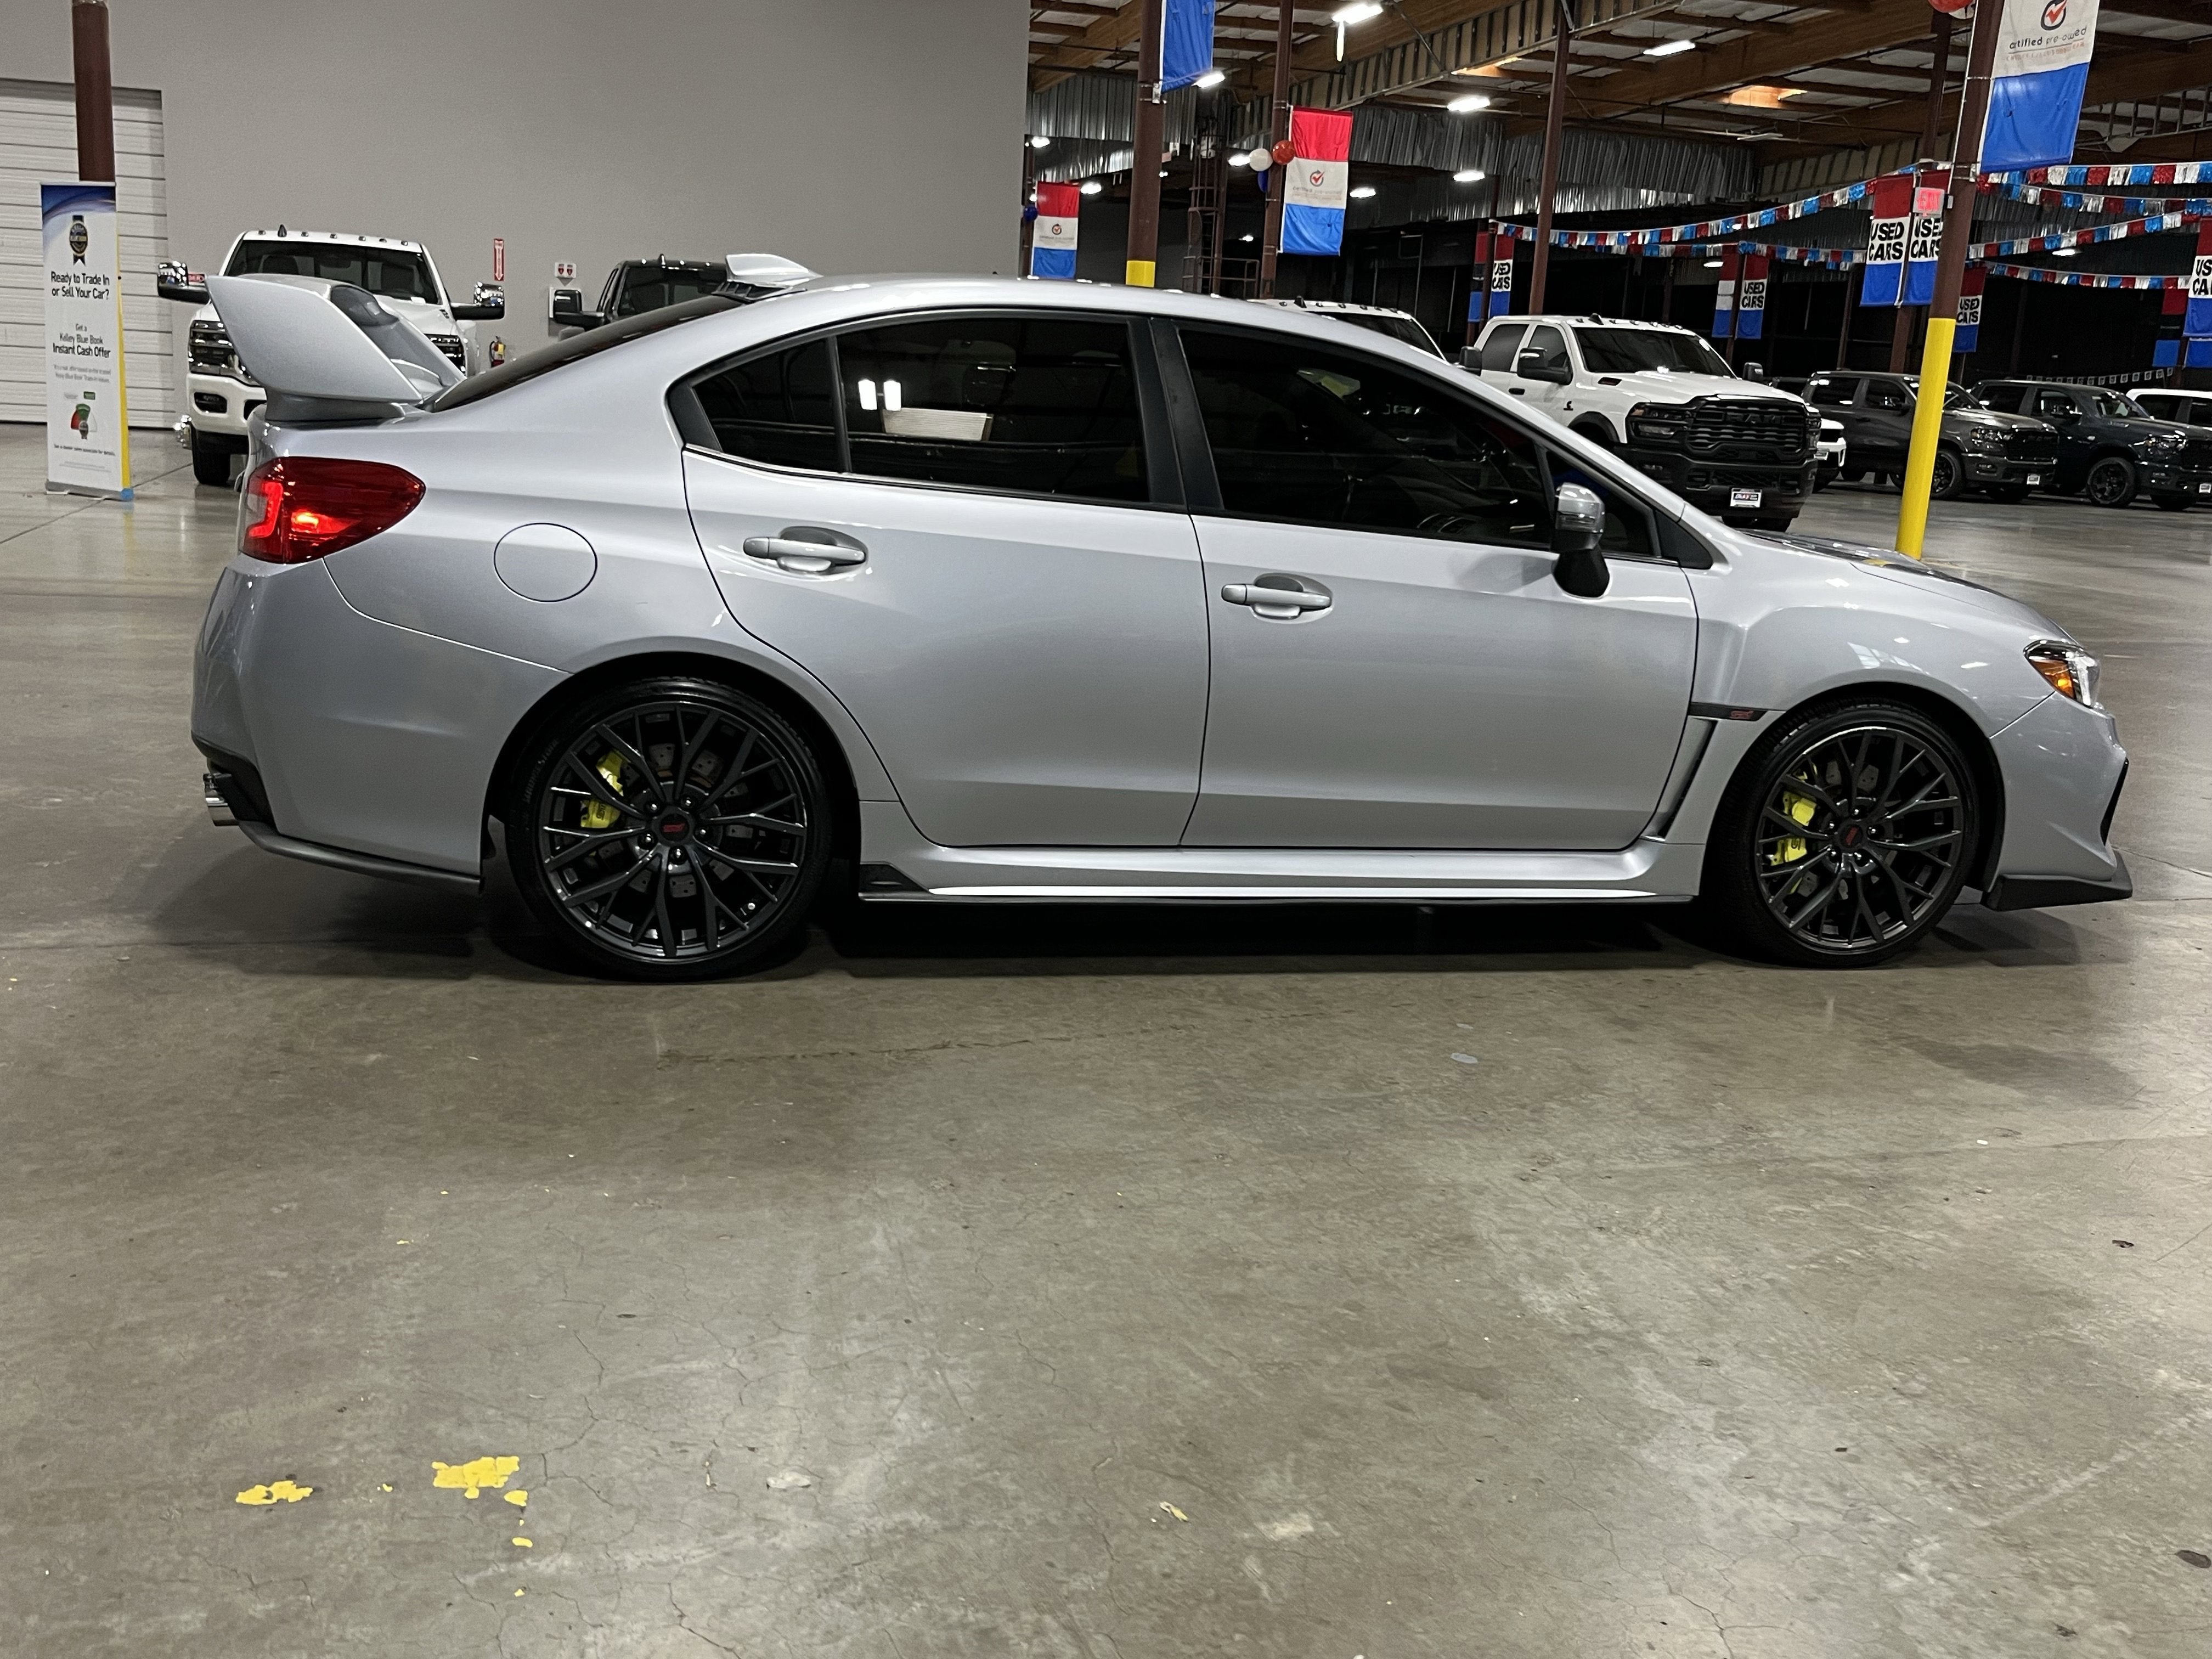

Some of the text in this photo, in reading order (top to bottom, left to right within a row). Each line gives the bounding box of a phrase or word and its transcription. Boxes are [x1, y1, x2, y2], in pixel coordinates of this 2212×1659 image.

[1871, 222, 1905, 241] USED
[1869, 241, 1903, 261] CARS
[2196, 259, 2212, 276] US
[51, 271, 110, 286] Ready to Trade In
[52, 286, 109, 300] or Sell Your Car?
[1744, 281, 1765, 295] USED
[1960, 298, 1980, 311] USED
[59, 332, 104, 346] Kelley Blue Book
[53, 342, 111, 358] Instant Cash Offer
